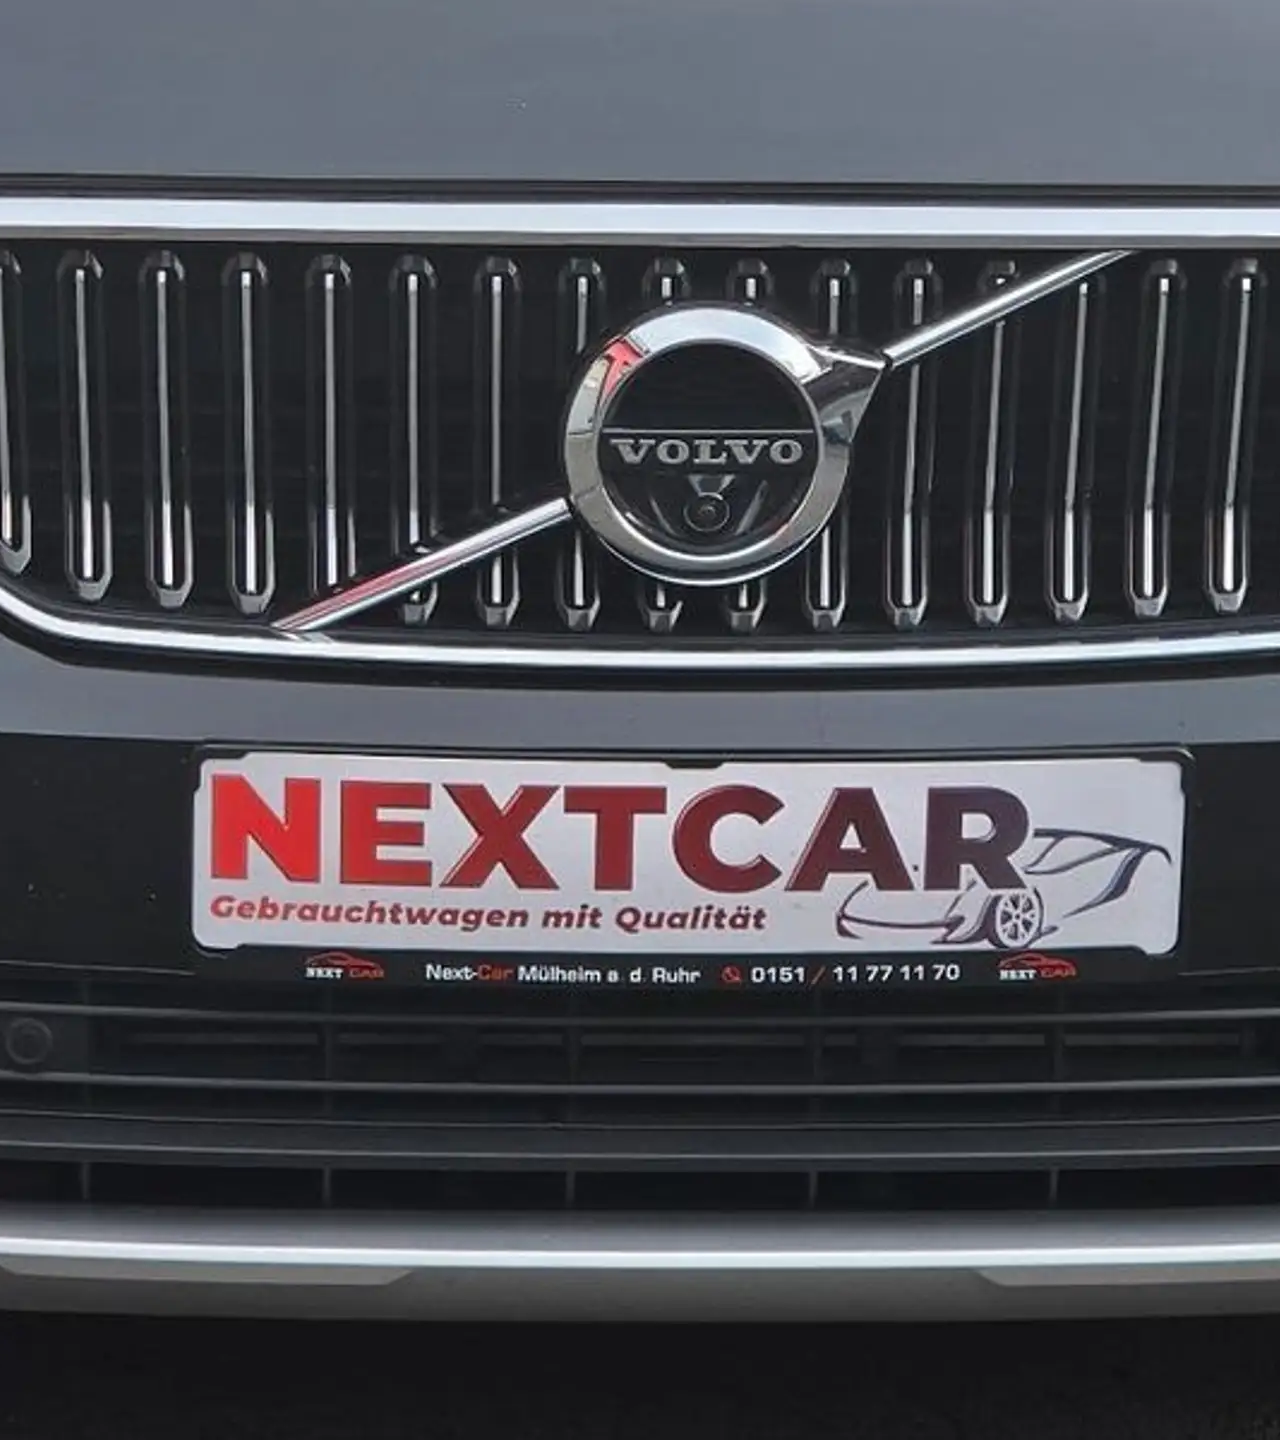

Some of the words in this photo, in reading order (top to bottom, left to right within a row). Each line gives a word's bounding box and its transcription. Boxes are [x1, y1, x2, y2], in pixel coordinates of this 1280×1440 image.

[610, 439, 802, 464] VOLVO
[210, 773, 1030, 894] NEXTCAR
[211, 895, 528, 932] Gebrauchtwagen
[541, 904, 602, 929] mit
[615, 904, 766, 934] Qualität
[305, 966, 344, 979] NEXT
[426, 964, 512, 981] Next-Car
[518, 965, 601, 983] Mülheim
[652, 968, 701, 984] Ruhr
[751, 966, 805, 983] 0151
[833, 965, 857, 982] 11
[865, 965, 893, 982] 77
[899, 965, 924, 982] 11
[932, 964, 960, 981] 70
[999, 968, 1036, 981] NEXT
